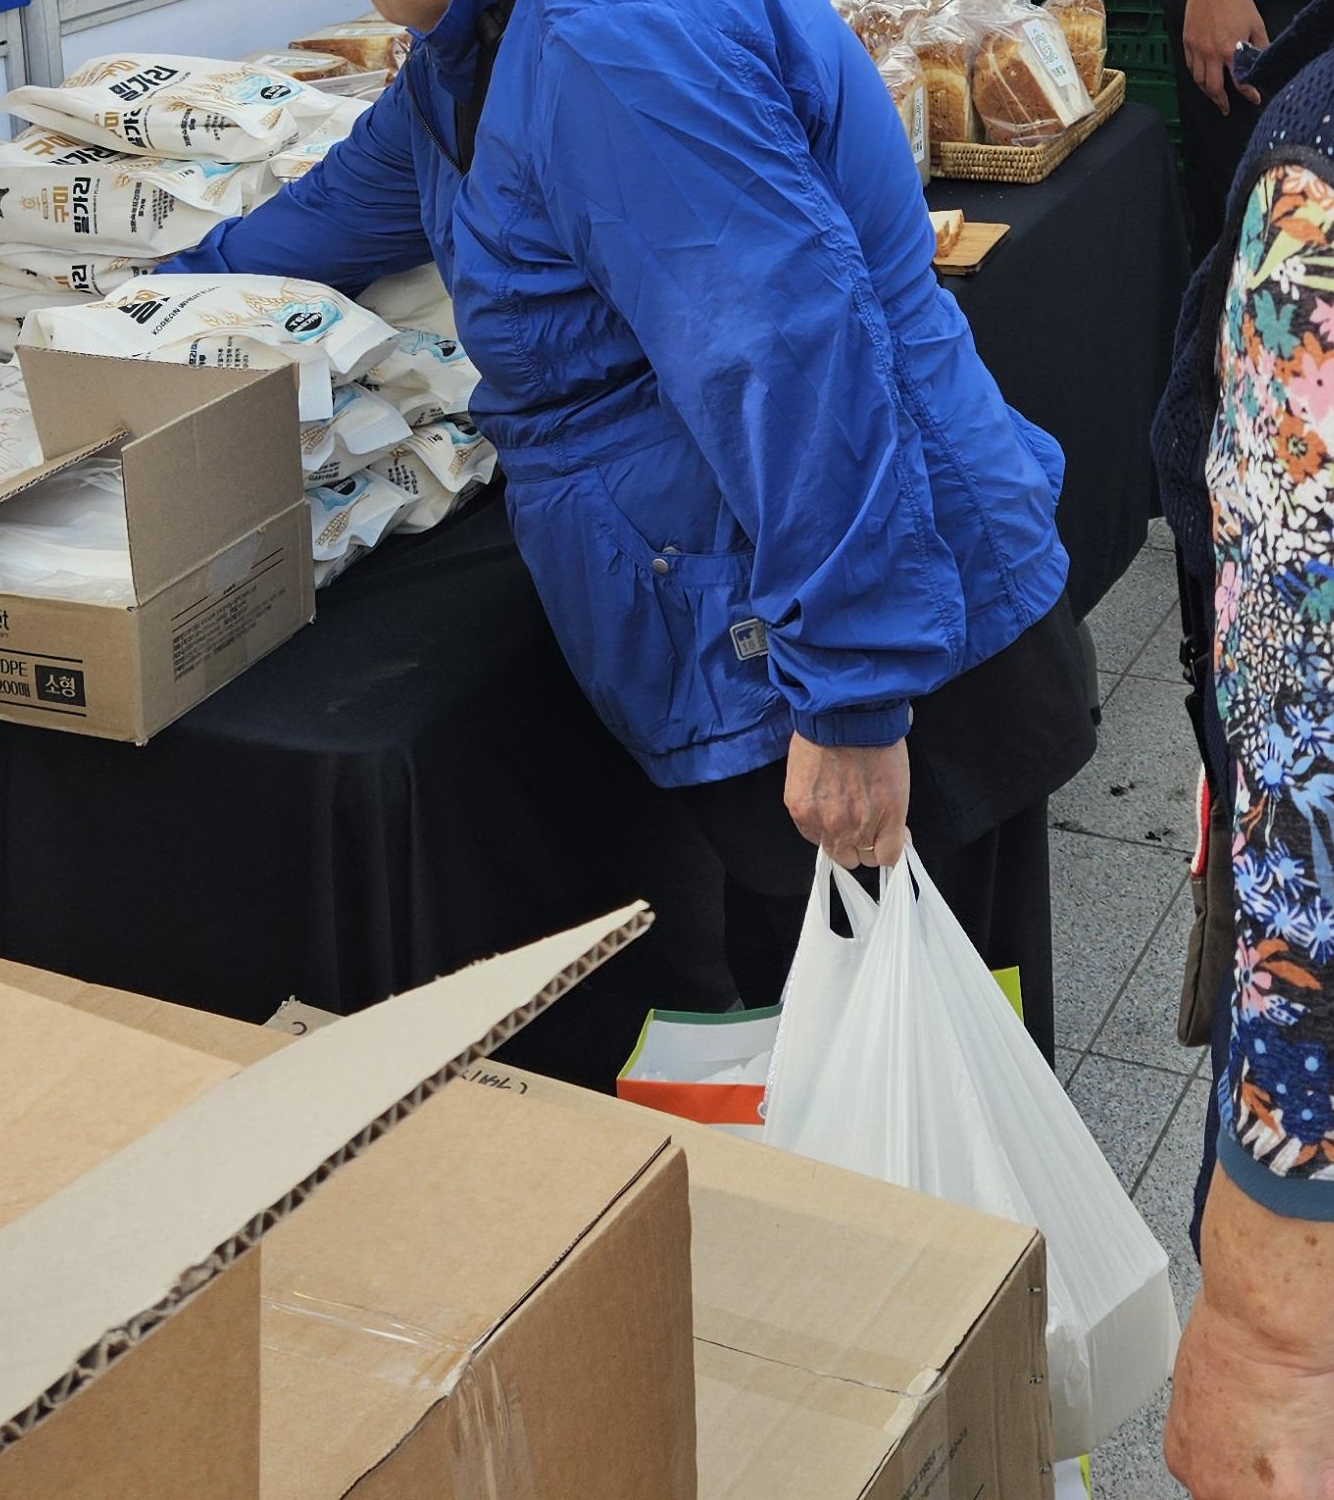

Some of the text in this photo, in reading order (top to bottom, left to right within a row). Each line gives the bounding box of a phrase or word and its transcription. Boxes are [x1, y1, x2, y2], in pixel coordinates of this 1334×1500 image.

[108, 65, 180, 101] 밀가리
[73, 176, 92, 235] 밀가리
[44, 674, 77, 698] 소형
